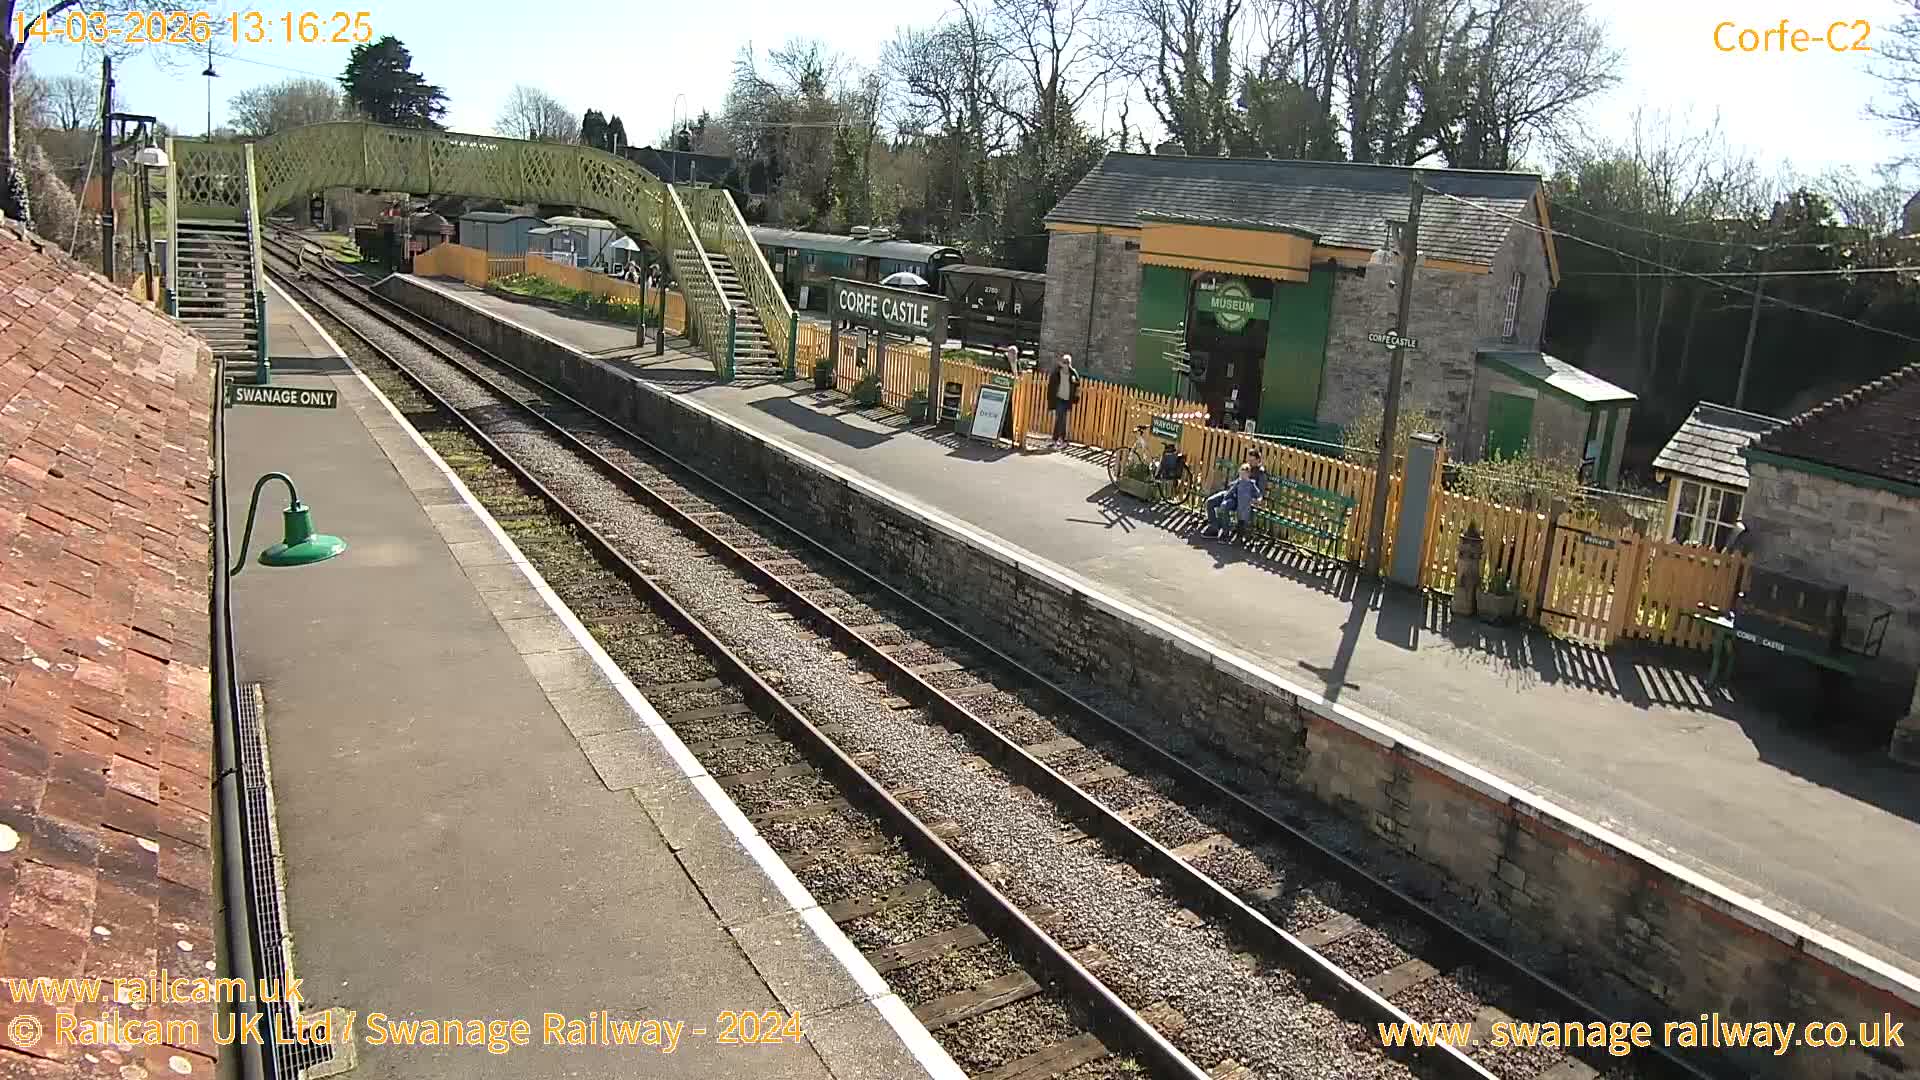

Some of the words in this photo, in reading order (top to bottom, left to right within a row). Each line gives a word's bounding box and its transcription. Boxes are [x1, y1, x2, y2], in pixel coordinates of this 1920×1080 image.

[840, 289, 878, 316] CORFE
[882, 298, 929, 327] CASTLE
[1211, 296, 1255, 313] MUSEUM
[1391, 336, 1416, 348] CASTLE
[236, 387, 297, 404] SWANAGE
[300, 392, 334, 405] ONLY
